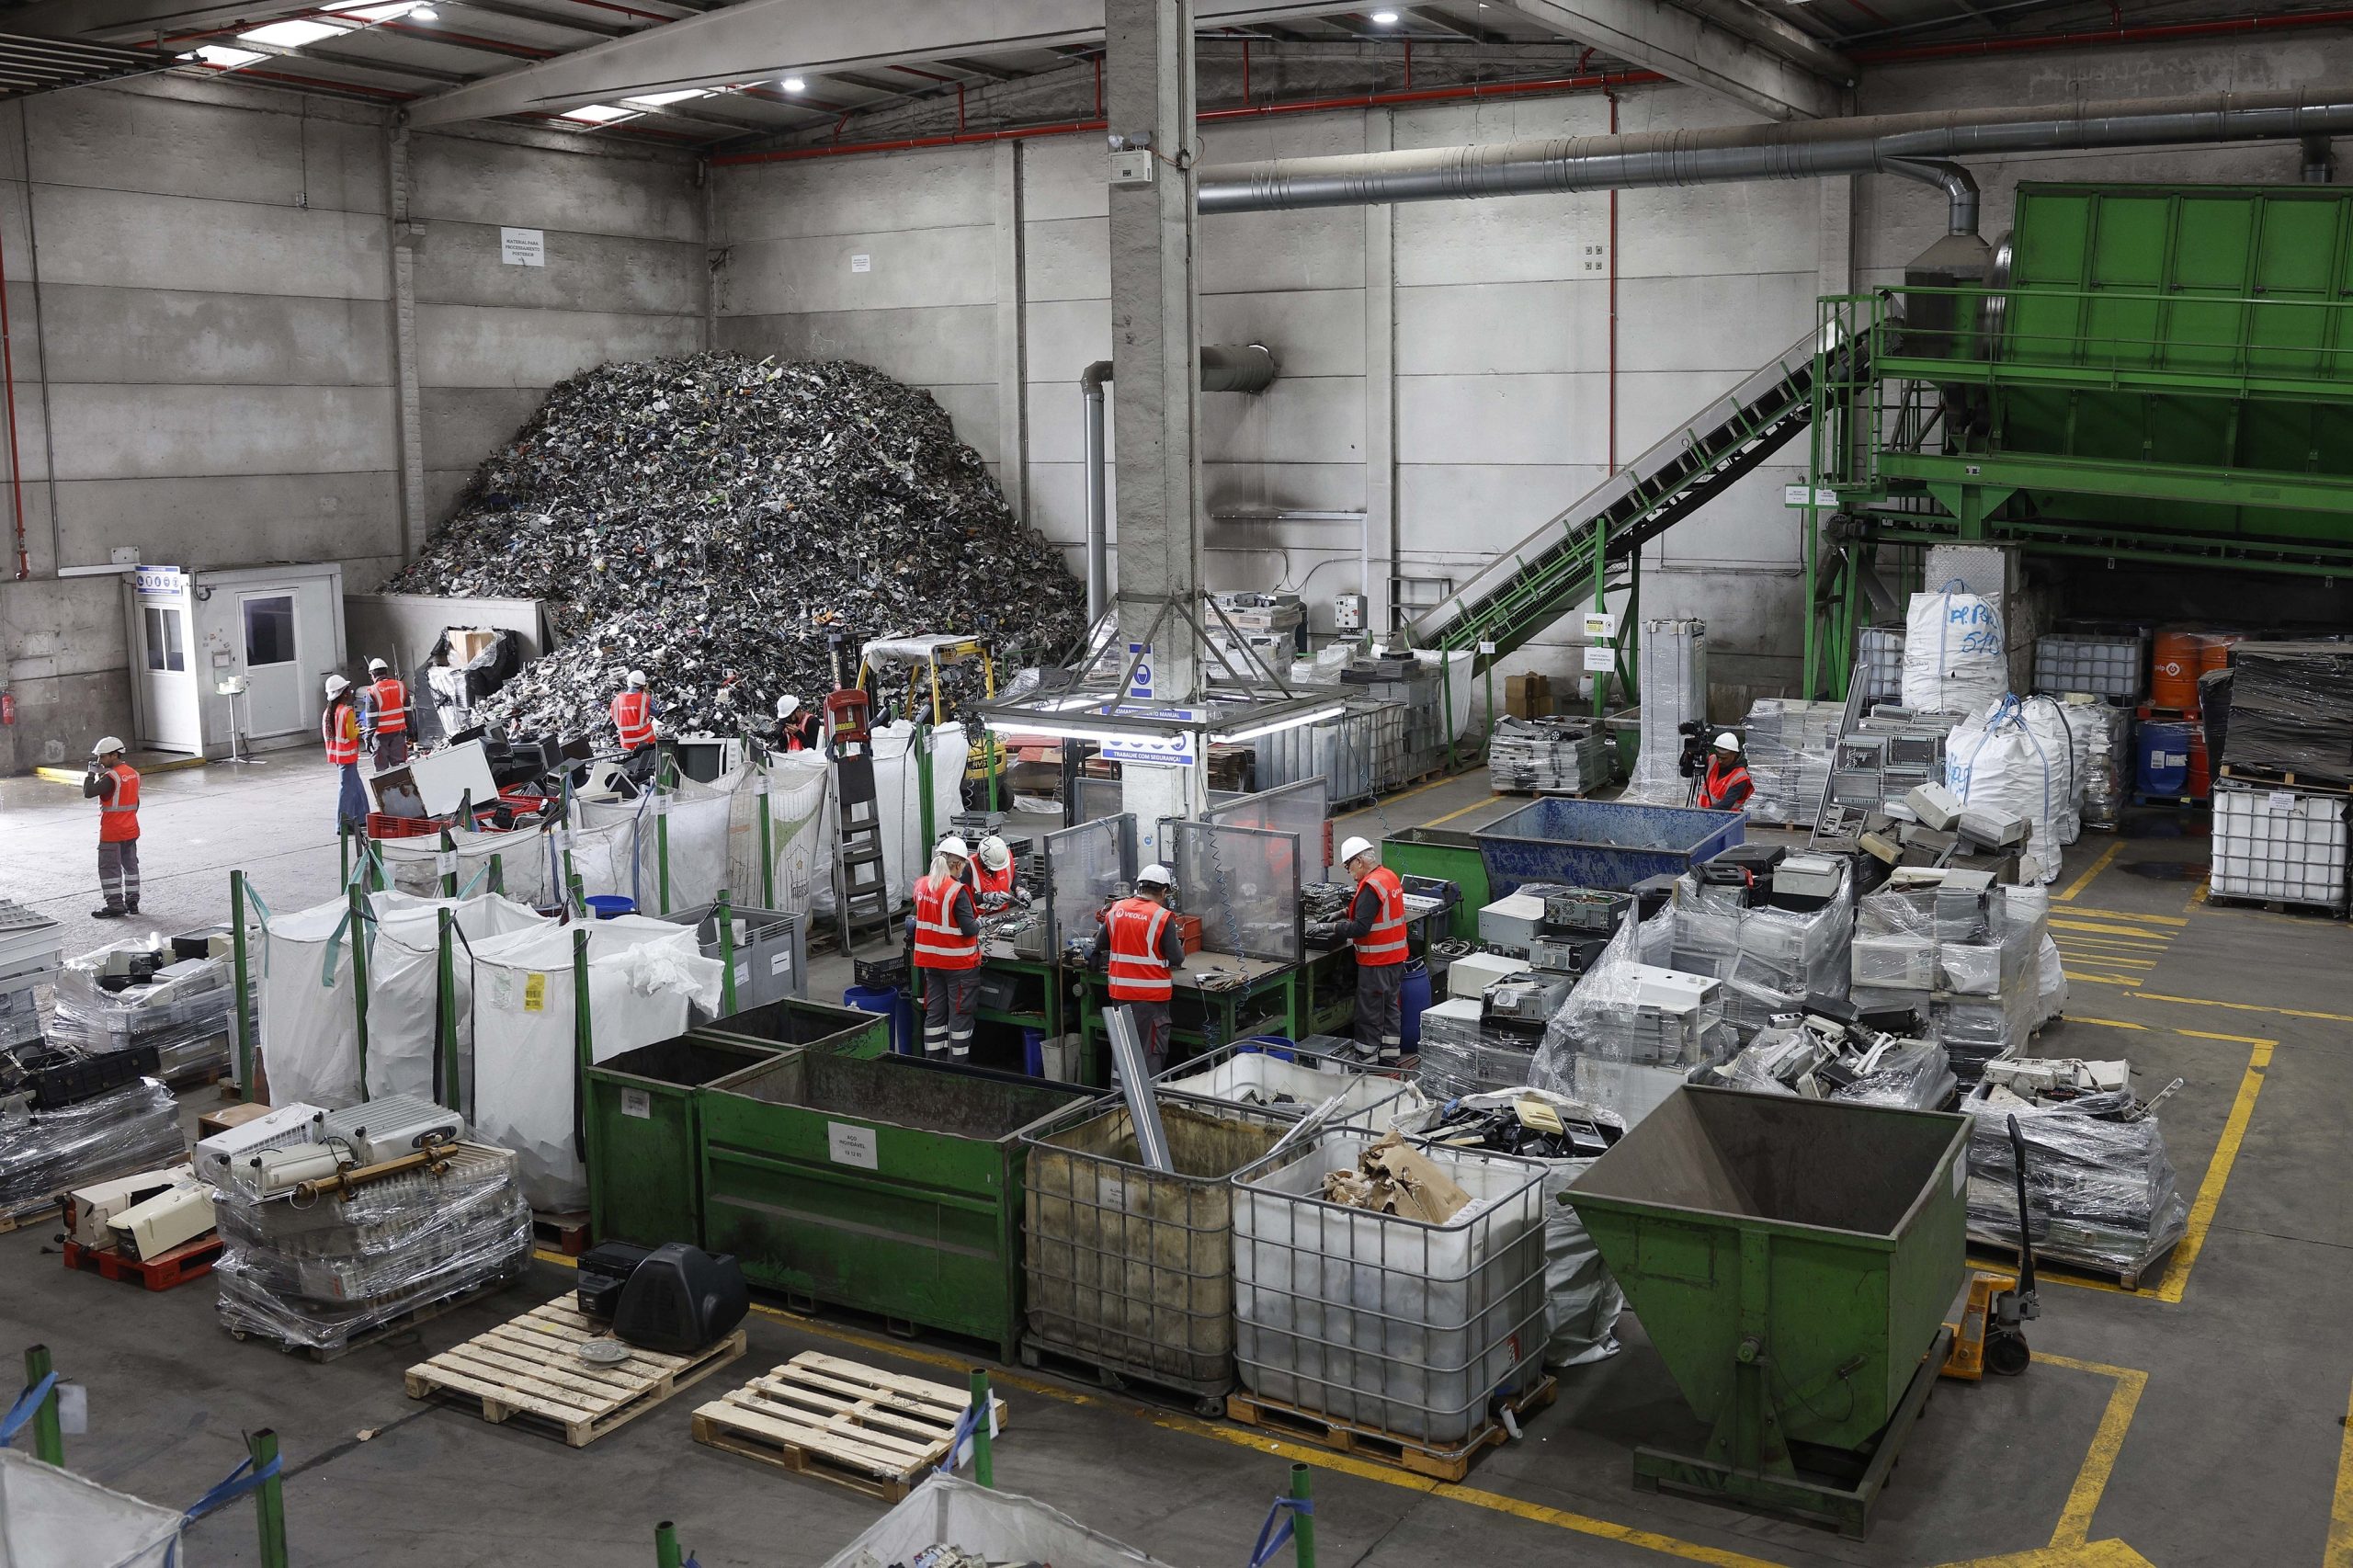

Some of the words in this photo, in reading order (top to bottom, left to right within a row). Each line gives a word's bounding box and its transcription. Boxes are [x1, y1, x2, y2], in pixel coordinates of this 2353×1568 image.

[1159, 710, 1181, 719] MANUAL
[1113, 751, 1138, 759] TRABALHE
[1151, 754, 1182, 763] SEGURANÇA!
[1124, 911, 1148, 921] VEOLIA
